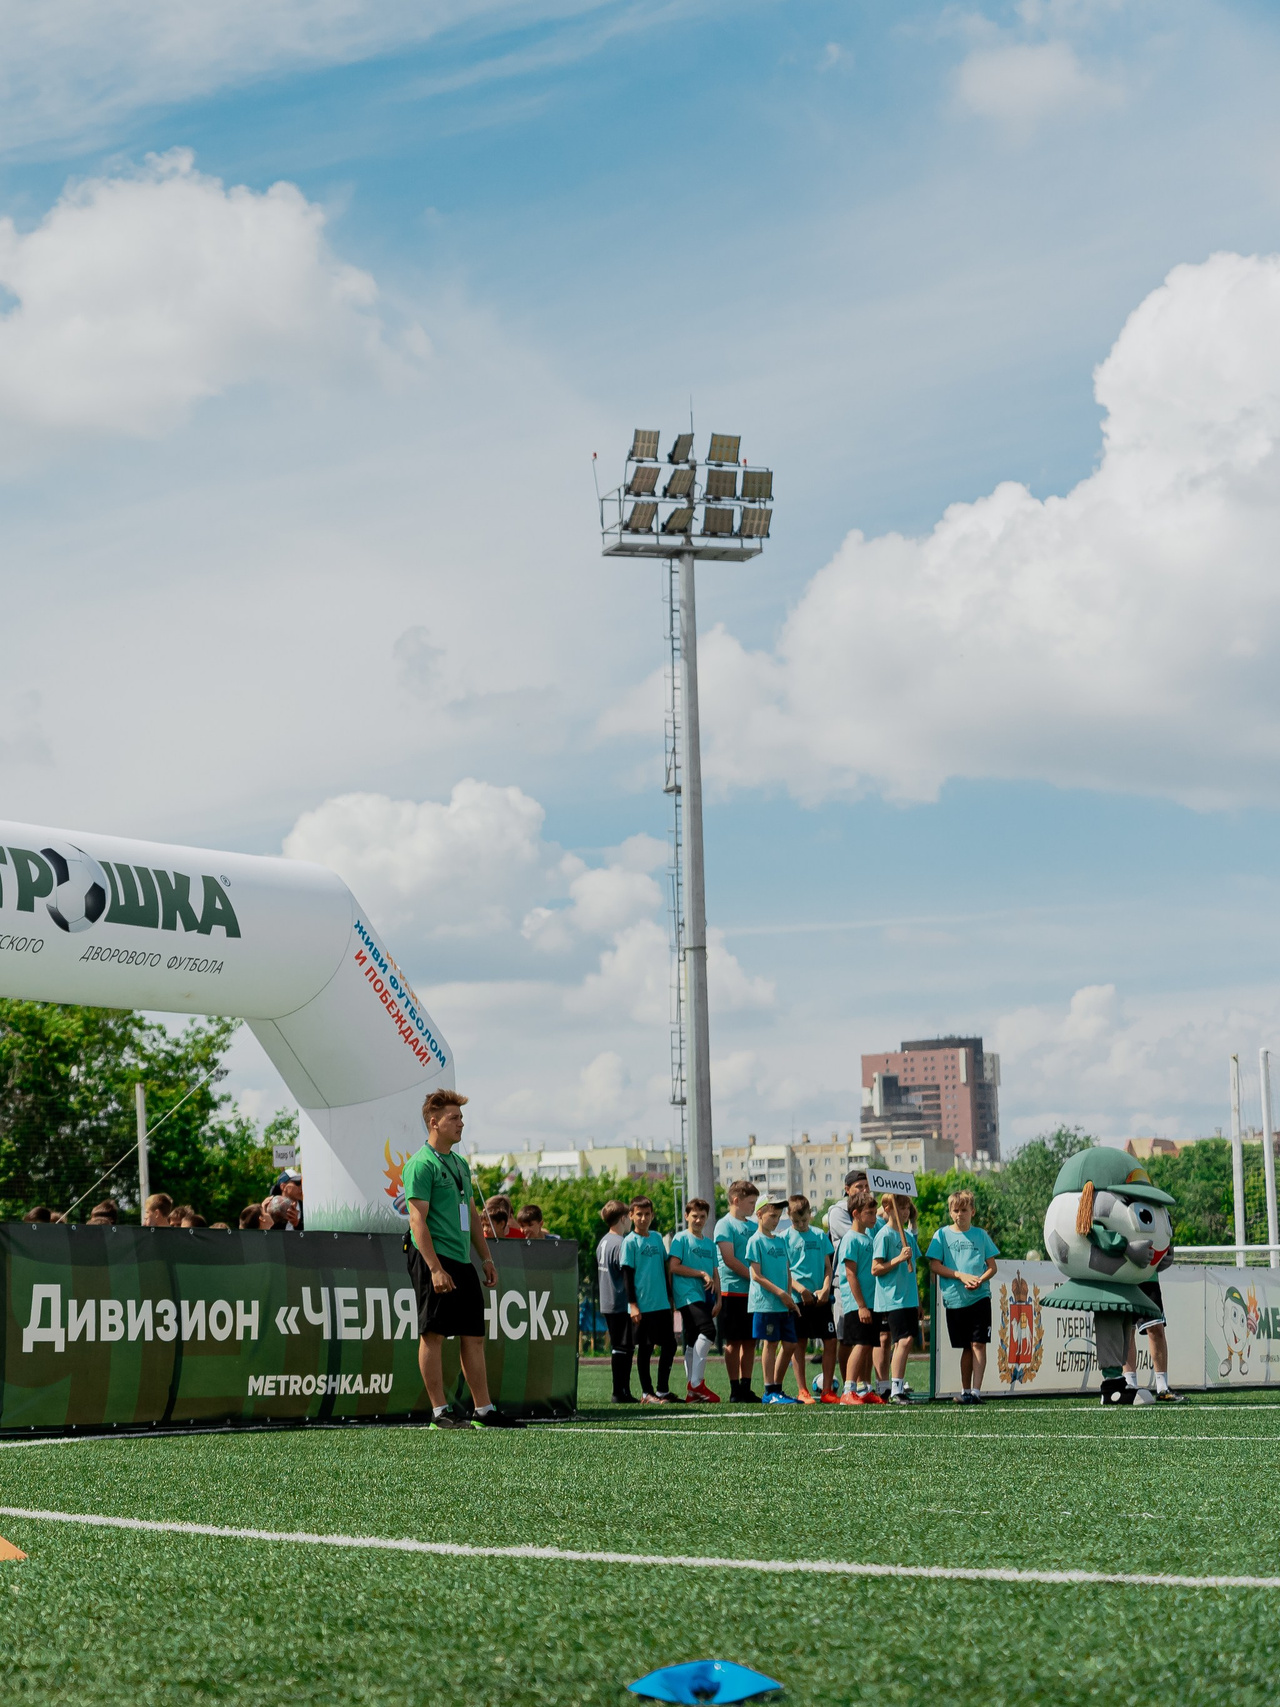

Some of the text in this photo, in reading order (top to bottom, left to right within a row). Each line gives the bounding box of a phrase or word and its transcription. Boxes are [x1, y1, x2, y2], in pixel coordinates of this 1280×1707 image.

[79, 945, 225, 974] ДВОРОВОГО ФУТБОЛА
[353, 919, 447, 1068] ЖИВИ ФУТБОЛОМ
[354, 948, 431, 1068] И ПОБЕЖДАЙ!
[872, 1175, 912, 1193] Юниор
[599, 1239, 609, 1265] 1
[22, 1283, 570, 1353] Дивизион «ЧЕЛЯНСК»
[827, 1322, 835, 1333] 8
[248, 1374, 393, 1396] METROSHKA.RU
